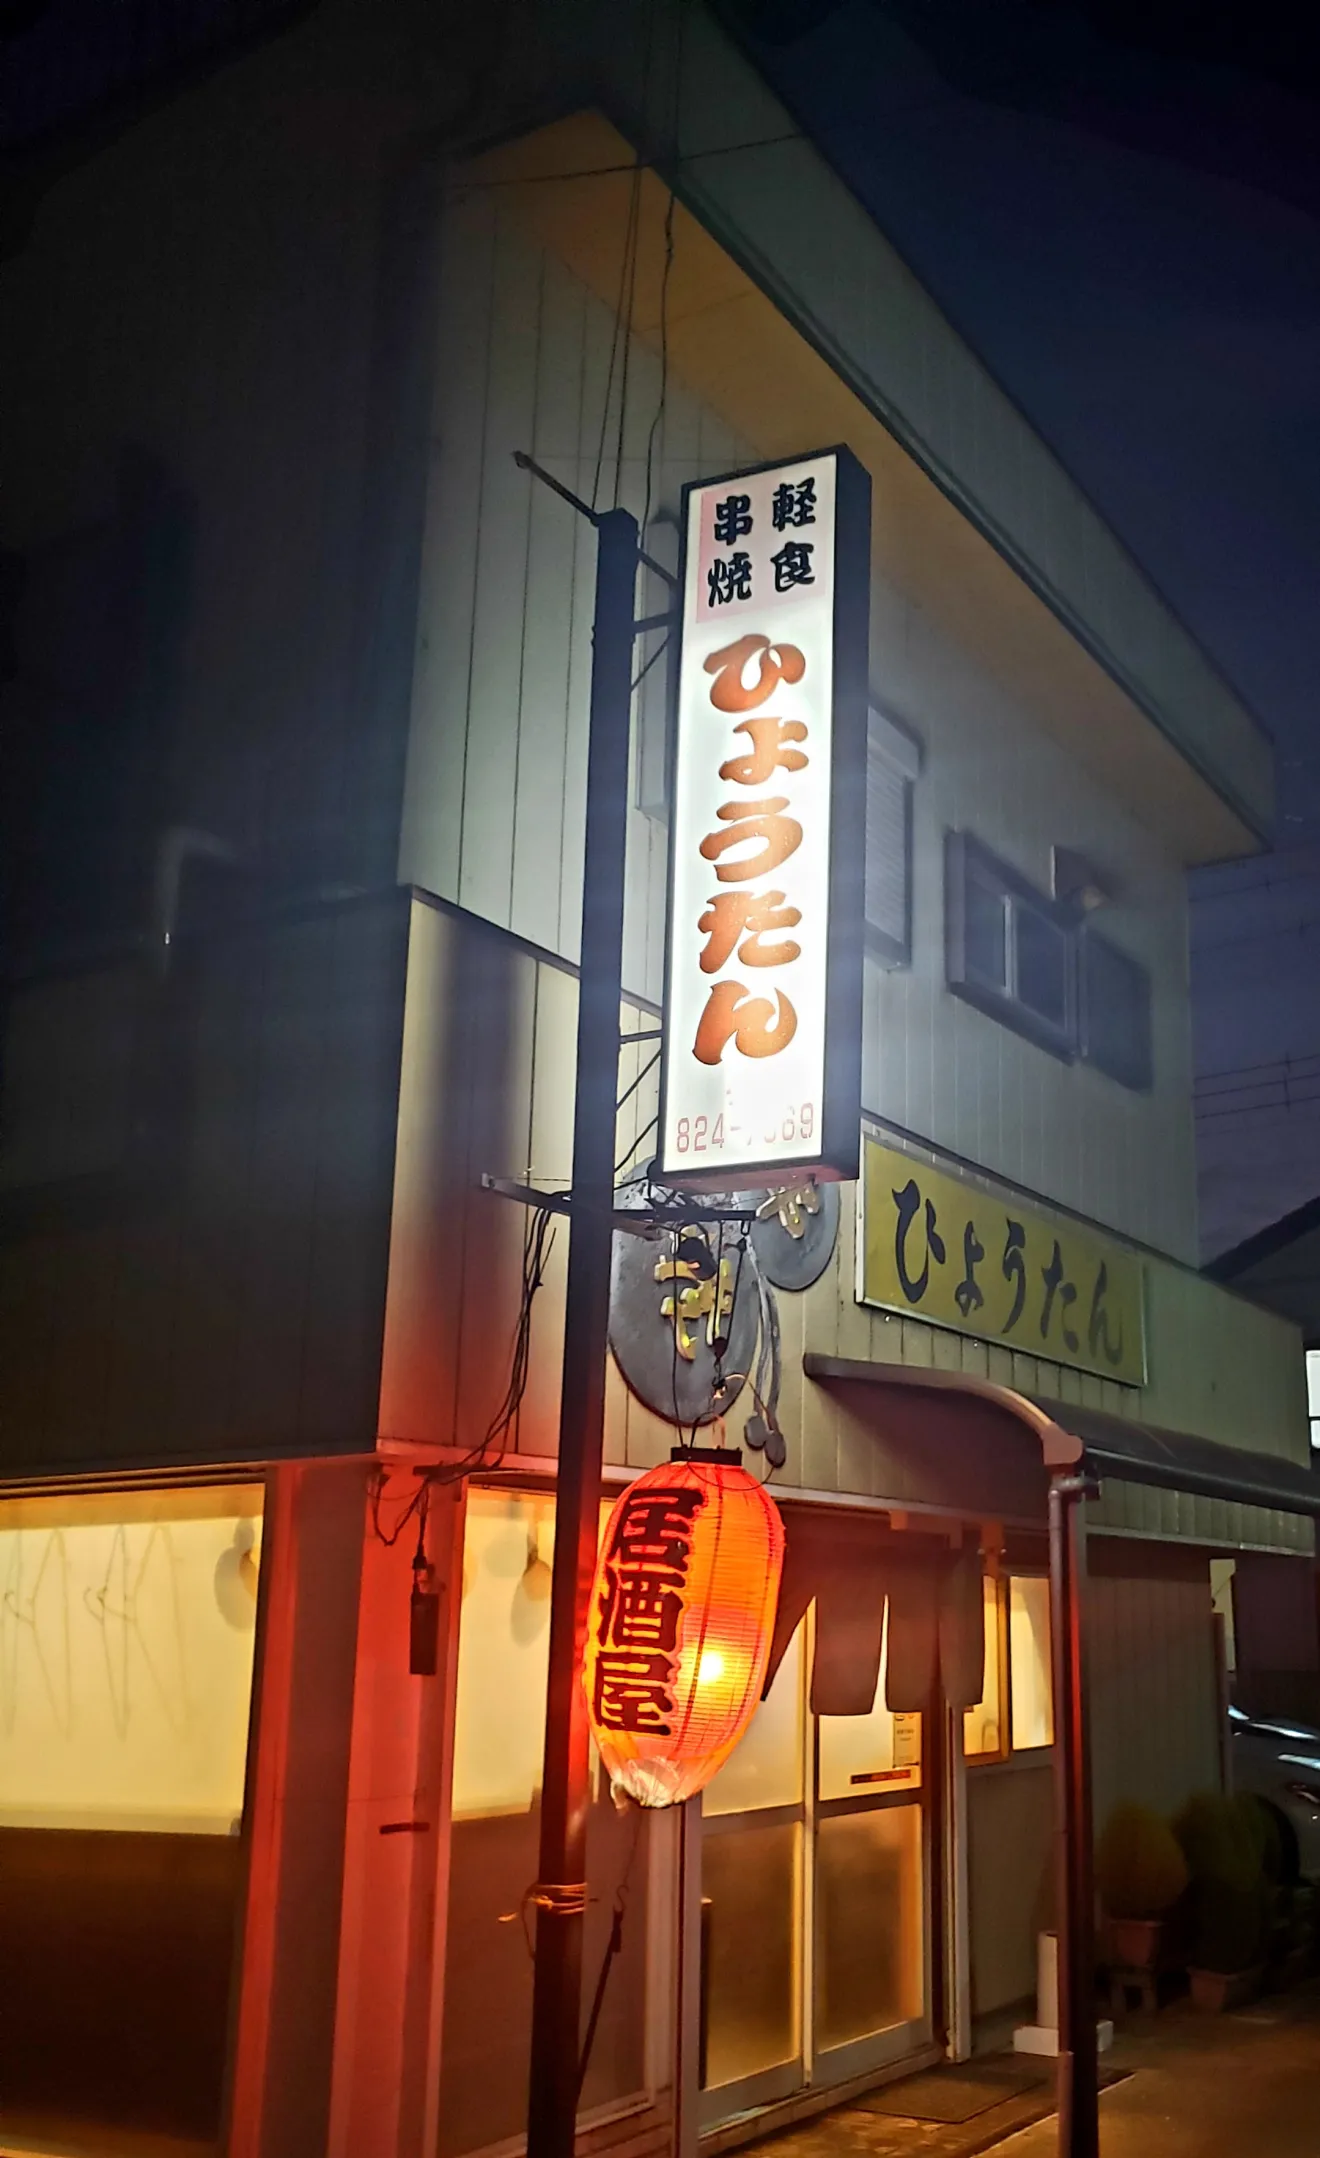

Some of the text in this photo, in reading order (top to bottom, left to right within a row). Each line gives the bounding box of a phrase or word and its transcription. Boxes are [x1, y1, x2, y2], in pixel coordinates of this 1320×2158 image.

[707, 495, 754, 607] 串焼
[770, 476, 817, 593] 軽食
[891, 1178, 1123, 1366] ひょうたん
[595, 1487, 708, 1736] 居酒屋
